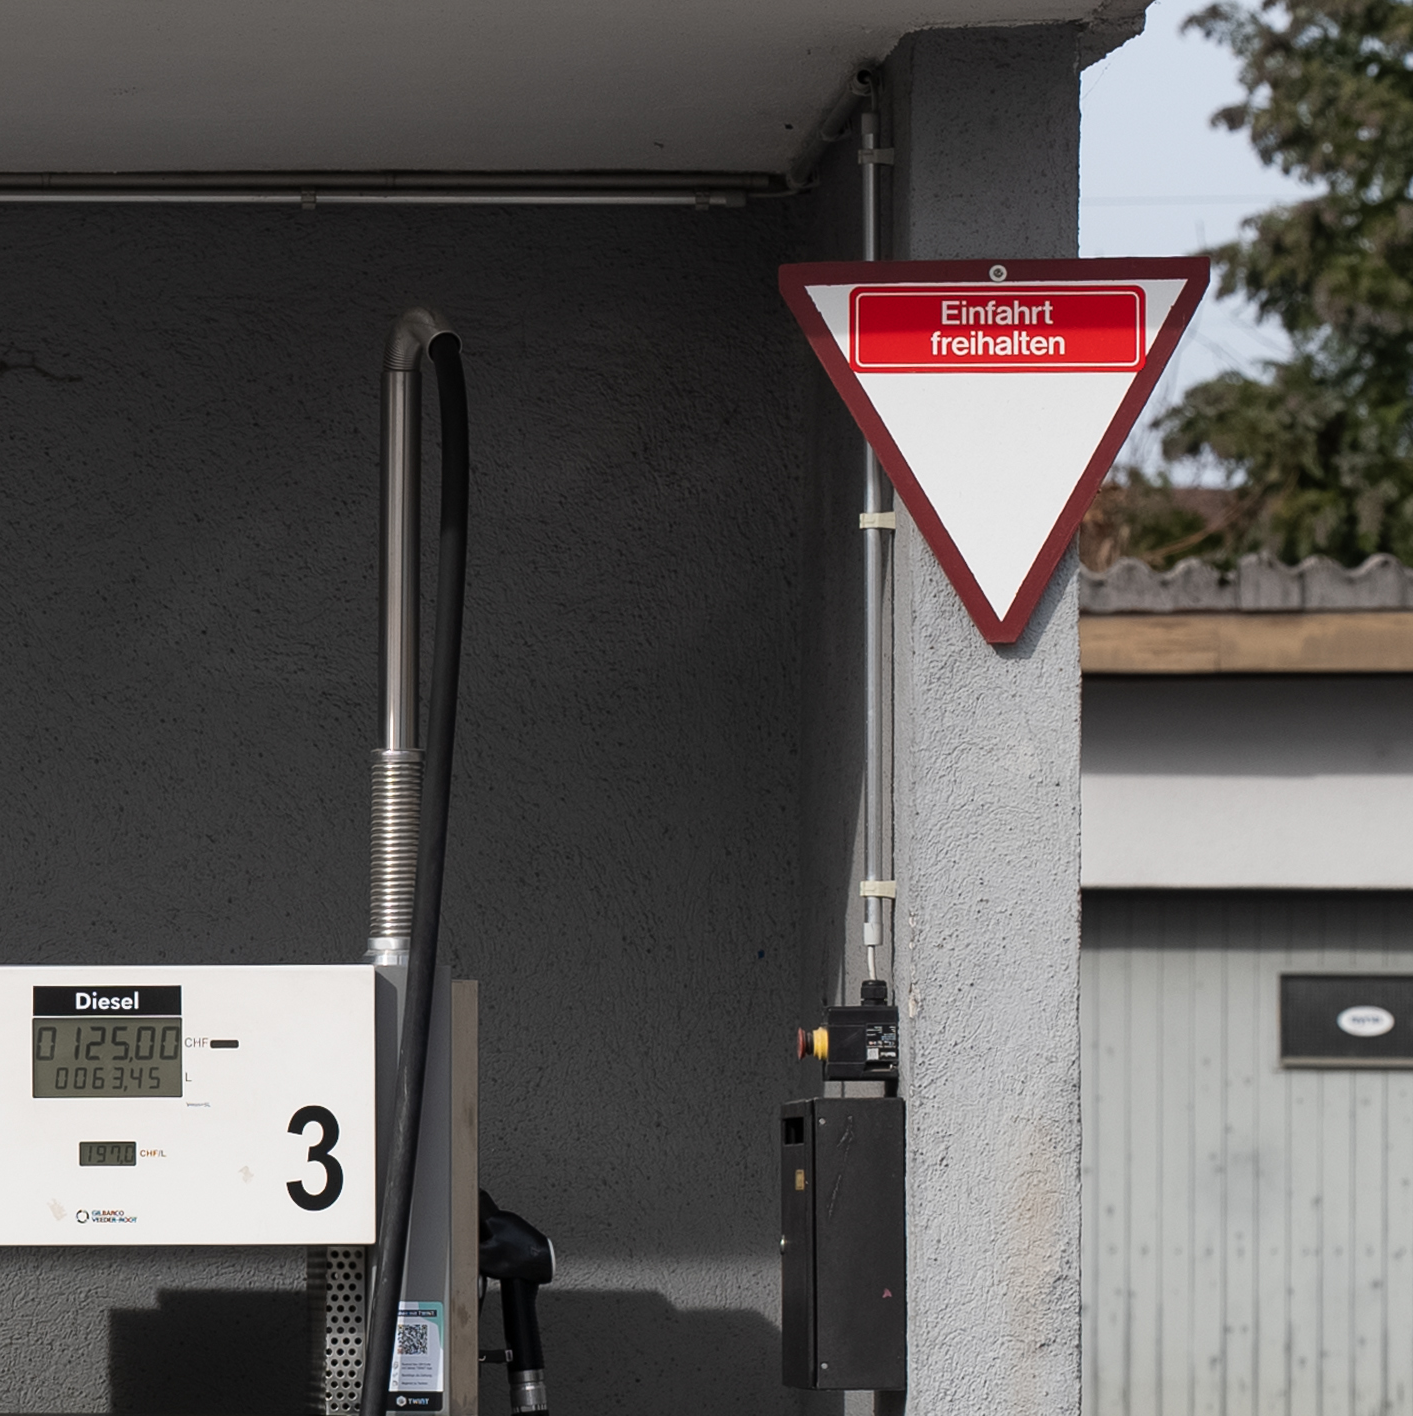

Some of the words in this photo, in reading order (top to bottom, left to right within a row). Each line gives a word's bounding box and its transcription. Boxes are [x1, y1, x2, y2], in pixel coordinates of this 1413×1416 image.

[941, 299, 1054, 326] Einfahrt
[930, 330, 1066, 356] freihalten
[75, 991, 140, 1010] Diesel
[184, 1037, 209, 1048] CHF
[185, 1072, 192, 1082] L
[140, 1149, 166, 1158] CHF/L
[286, 1105, 344, 1211] 3
